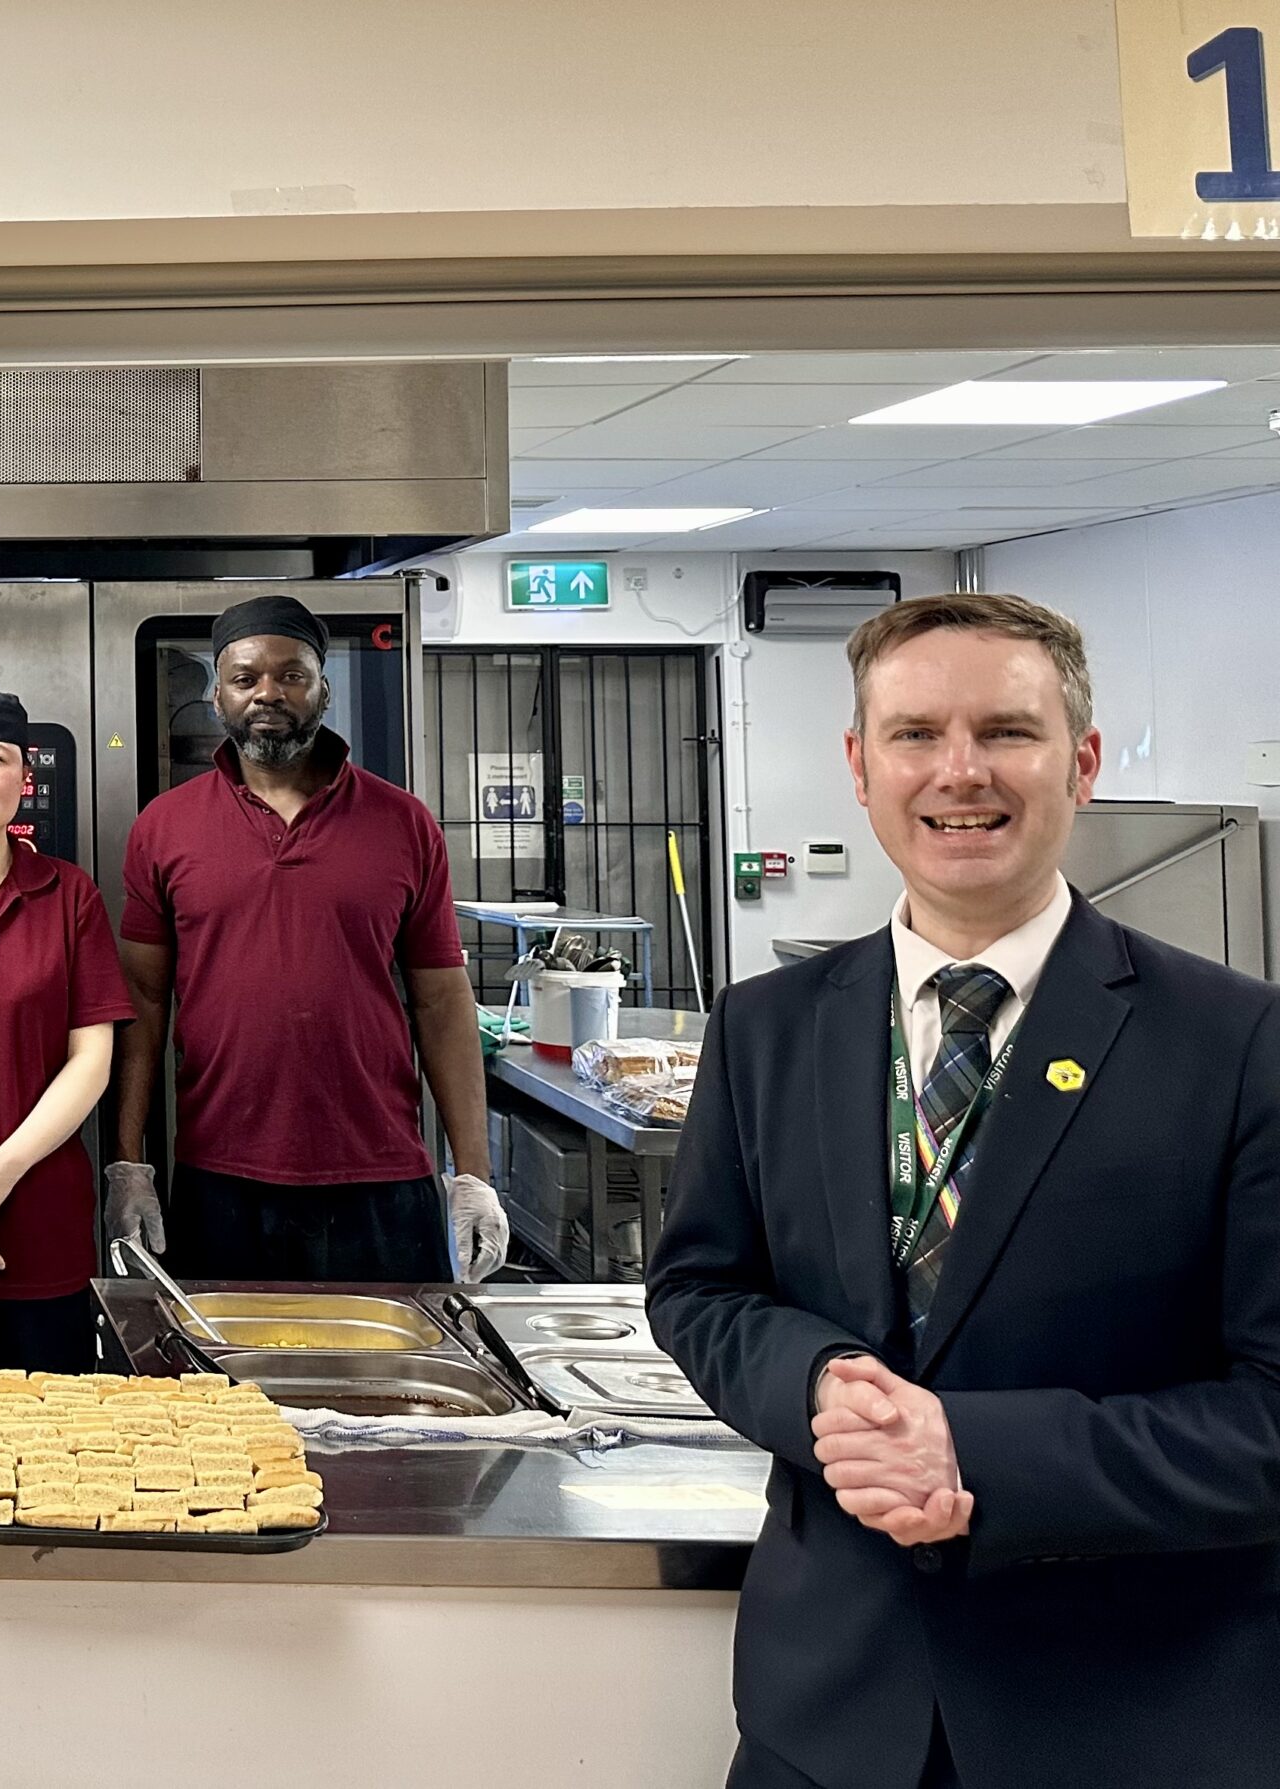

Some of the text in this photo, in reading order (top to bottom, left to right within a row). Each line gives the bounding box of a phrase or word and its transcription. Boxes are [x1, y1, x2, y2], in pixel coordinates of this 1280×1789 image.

[1187, 27, 1280, 203] 1
[894, 1056, 909, 1101] VISITOR
[899, 1132, 912, 1184] VISITOR
[925, 1137, 953, 1187] VISITOR
